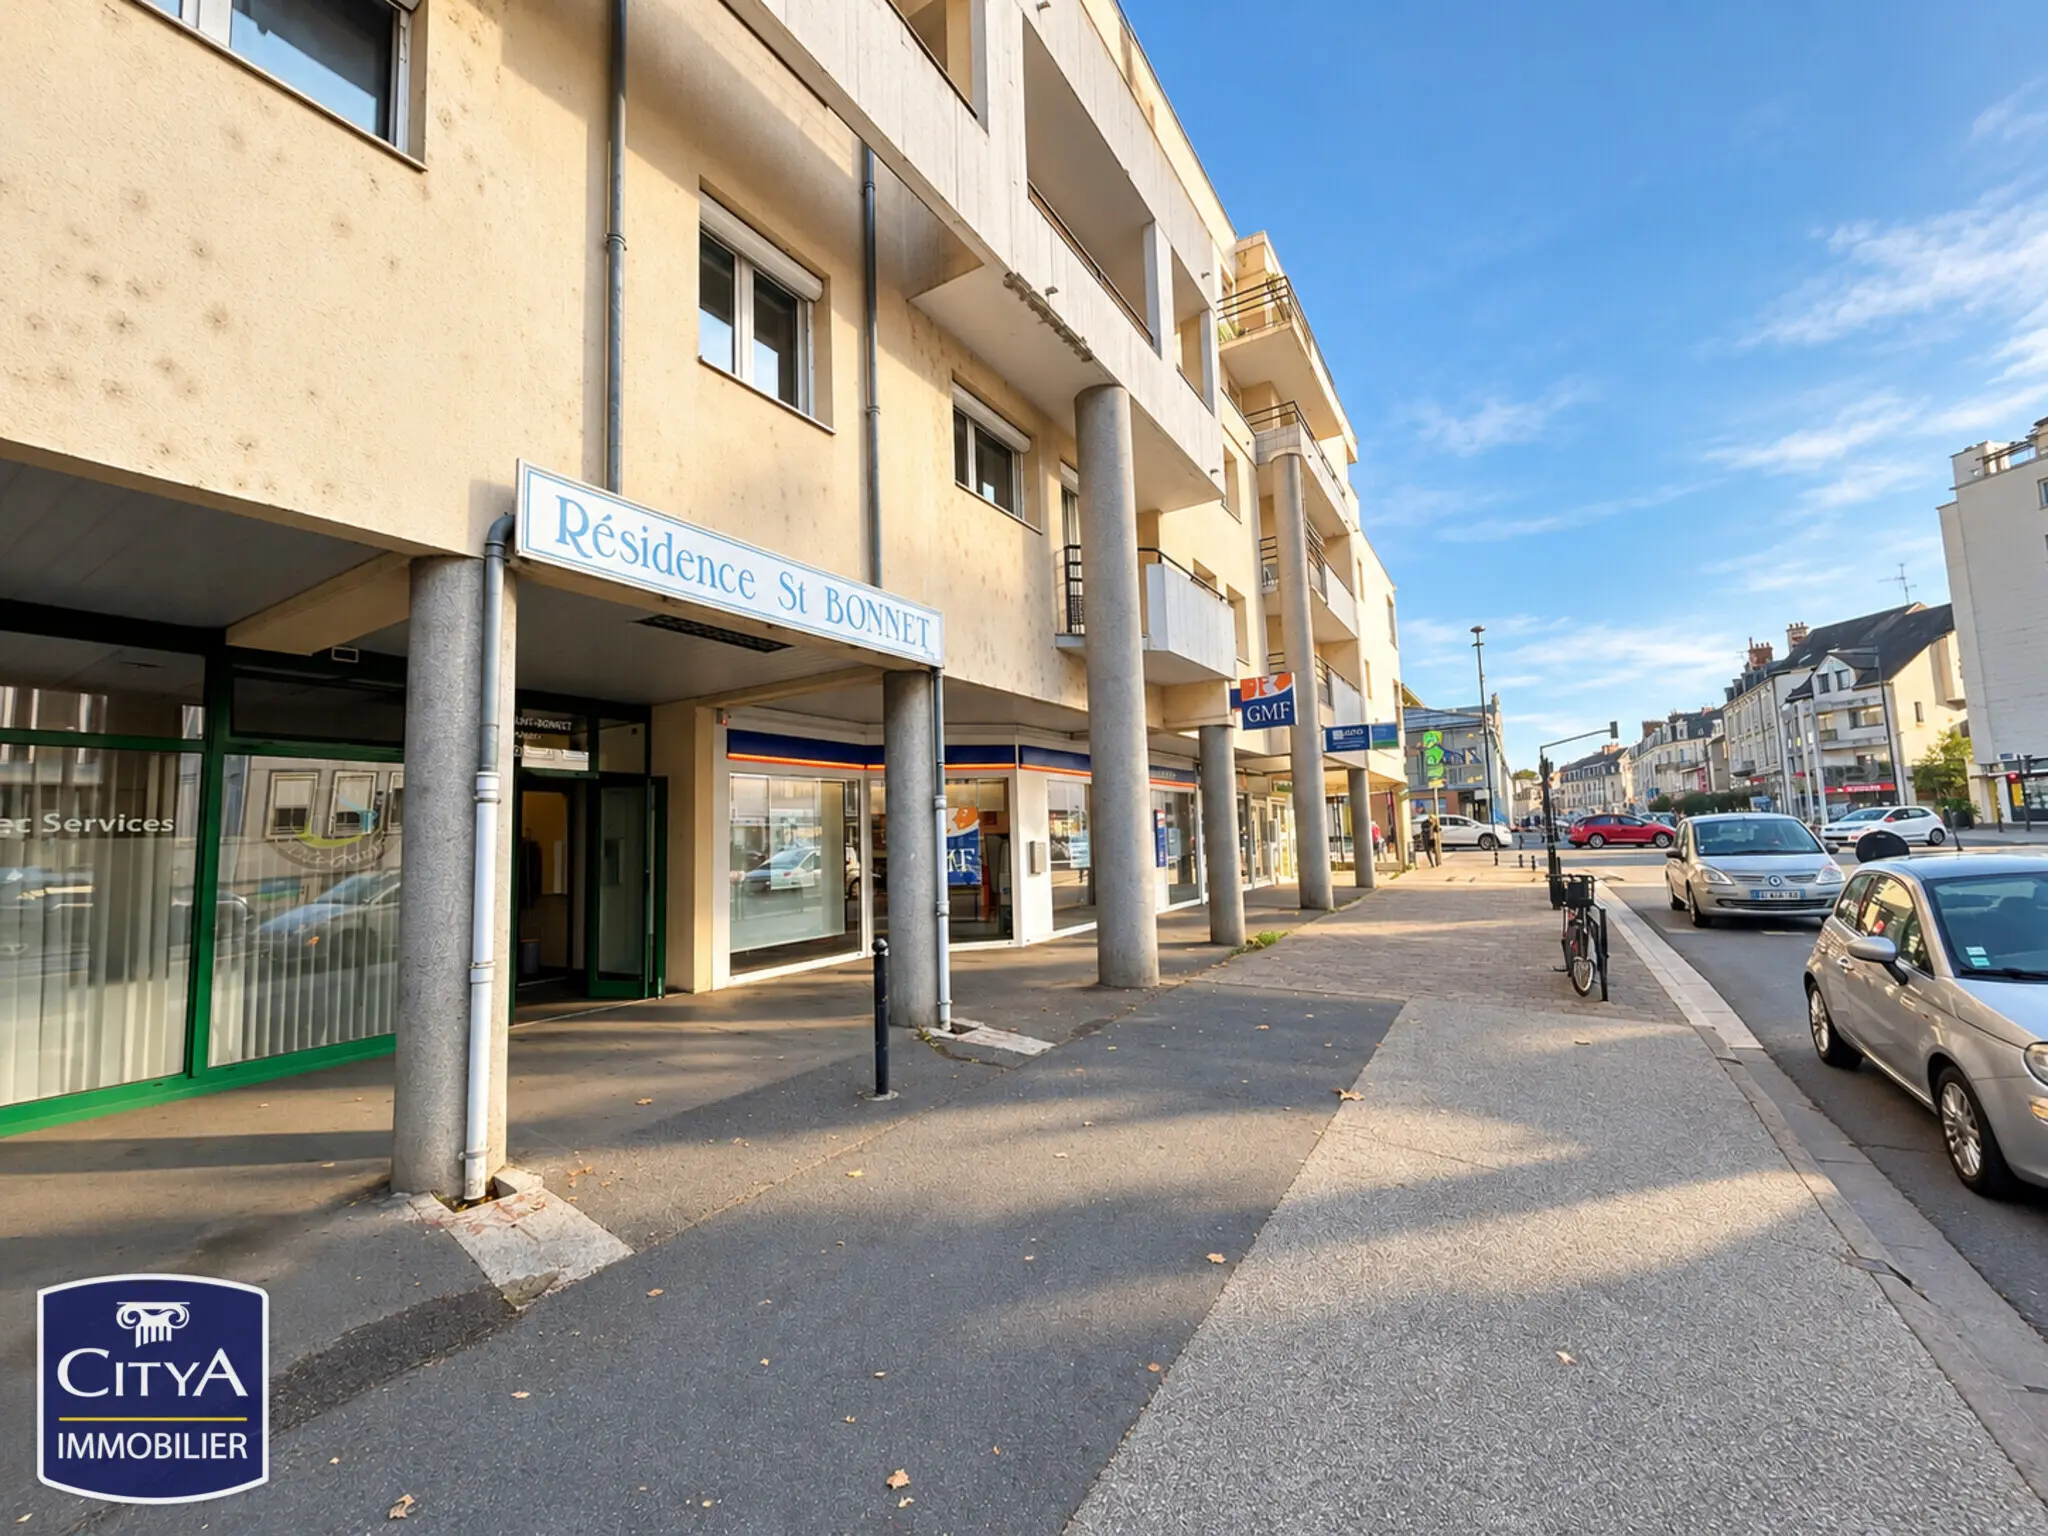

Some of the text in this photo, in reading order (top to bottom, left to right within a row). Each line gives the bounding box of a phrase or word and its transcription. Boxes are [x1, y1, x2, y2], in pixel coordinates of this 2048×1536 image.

[555, 494, 931, 649] Résidence St BONNET
[1246, 701, 1291, 723] GMF
[42, 812, 175, 833] Services
